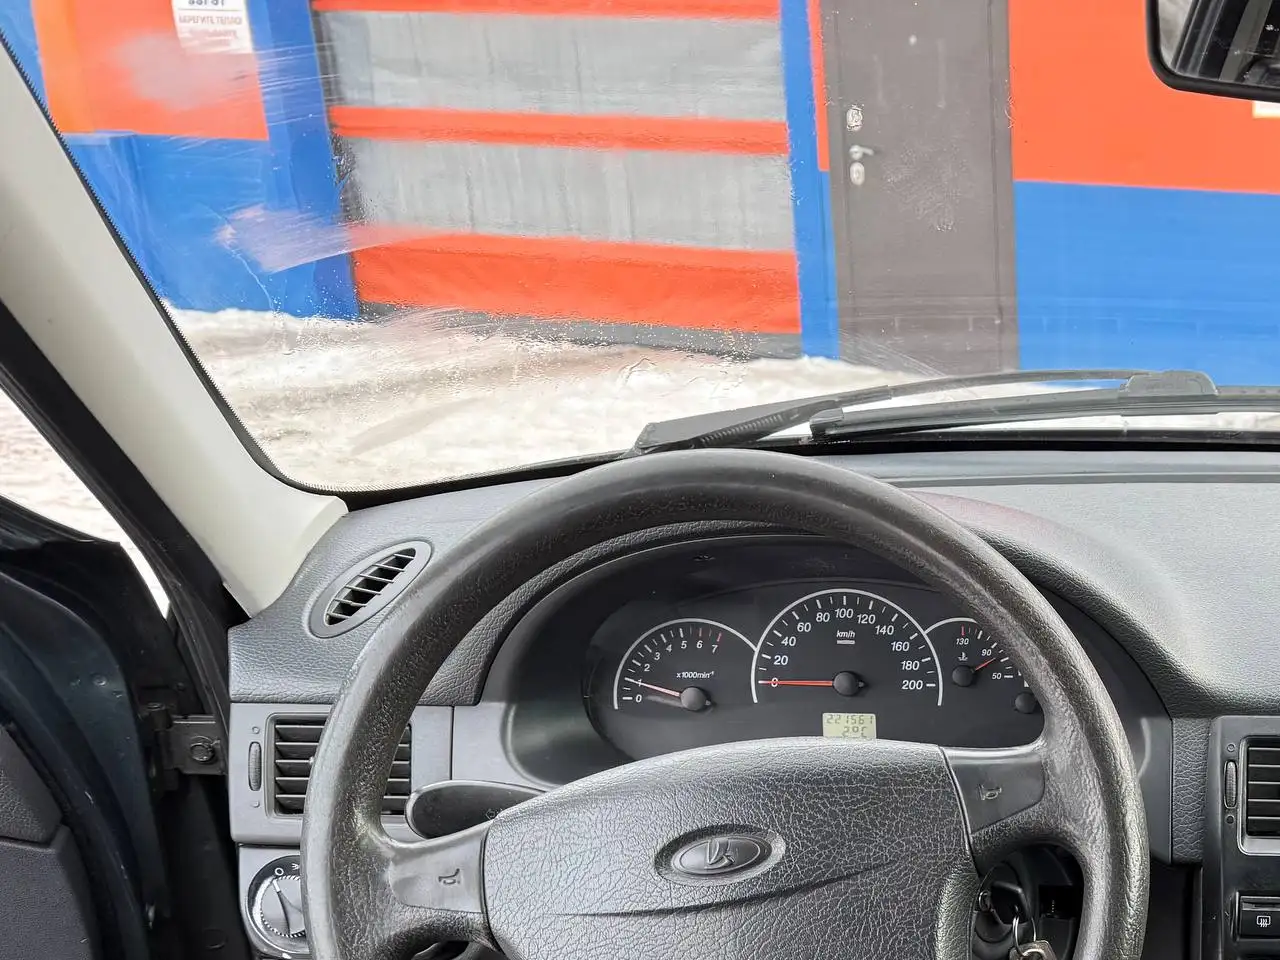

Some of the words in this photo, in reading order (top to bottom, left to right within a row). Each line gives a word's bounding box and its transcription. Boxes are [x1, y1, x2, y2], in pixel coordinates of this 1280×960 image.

[815, 612, 831, 623] 80
[834, 608, 854, 619] 100
[856, 614, 876, 624] 120
[796, 622, 812, 633] 60
[875, 625, 895, 636] 140
[836, 630, 856, 639] km/h
[680, 641, 688, 649] 5
[696, 640, 704, 649] 6
[780, 636, 797, 647] 40
[665, 644, 673, 653] 4
[711, 644, 719, 653] 7
[890, 641, 910, 652] 160
[653, 652, 661, 661] 3
[981, 648, 992, 656] 90
[773, 655, 789, 666] 20
[643, 663, 651, 672] 2
[900, 660, 920, 671] 180
[991, 672, 1002, 680] 50
[901, 680, 924, 690] 200
[635, 694, 643, 703] 0
